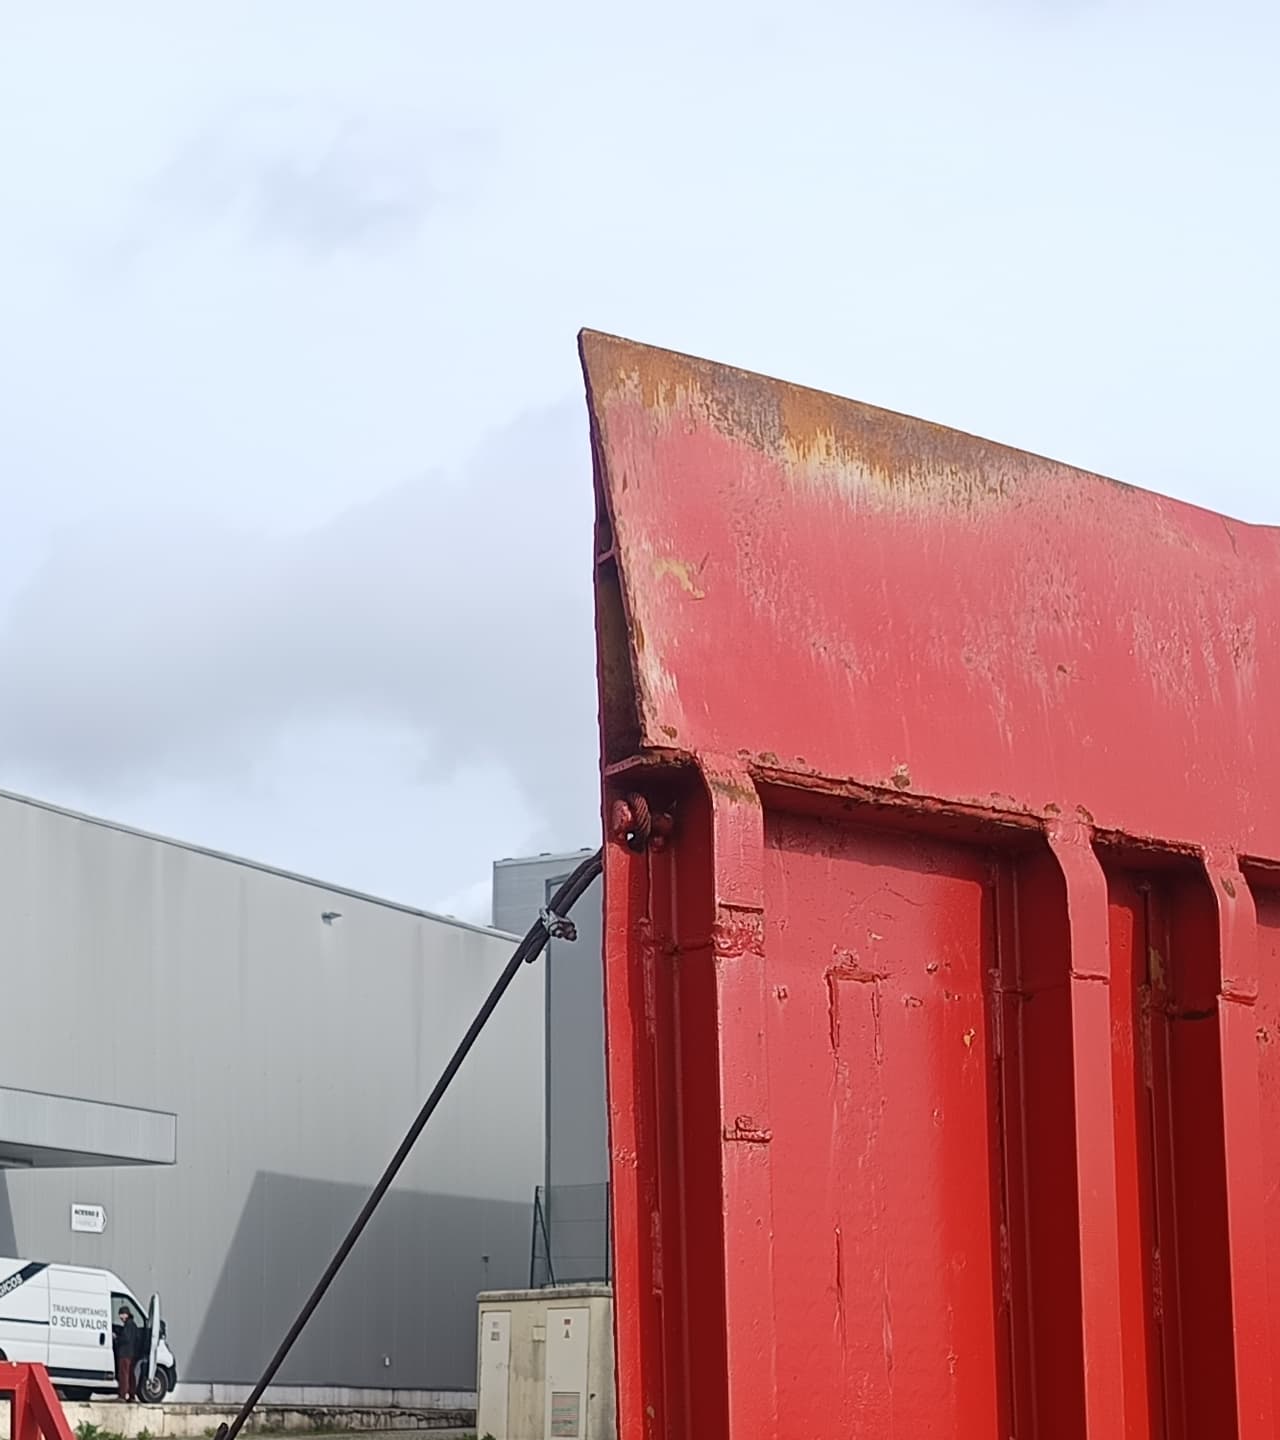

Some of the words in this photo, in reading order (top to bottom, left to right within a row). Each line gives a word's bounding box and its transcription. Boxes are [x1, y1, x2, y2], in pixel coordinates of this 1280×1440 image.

[51, 1315, 58, 1326] O
[60, 1316, 78, 1328] SEU
[80, 1318, 108, 1331] VALOR
